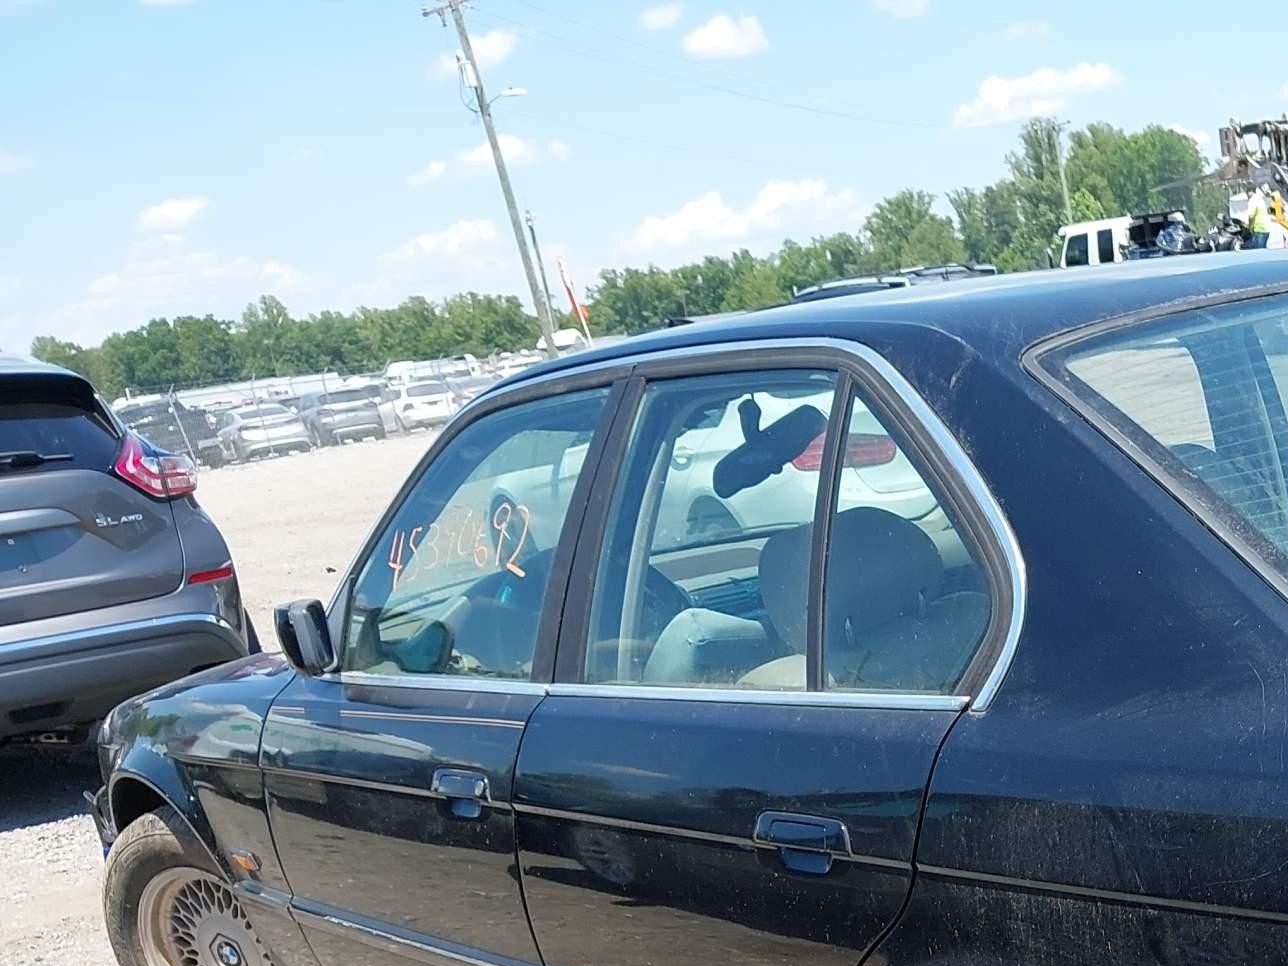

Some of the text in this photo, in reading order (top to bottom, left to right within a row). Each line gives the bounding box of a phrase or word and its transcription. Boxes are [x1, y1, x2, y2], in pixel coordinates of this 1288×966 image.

[96, 514, 143, 527] SL AWD
[388, 501, 529, 592] 45390692
